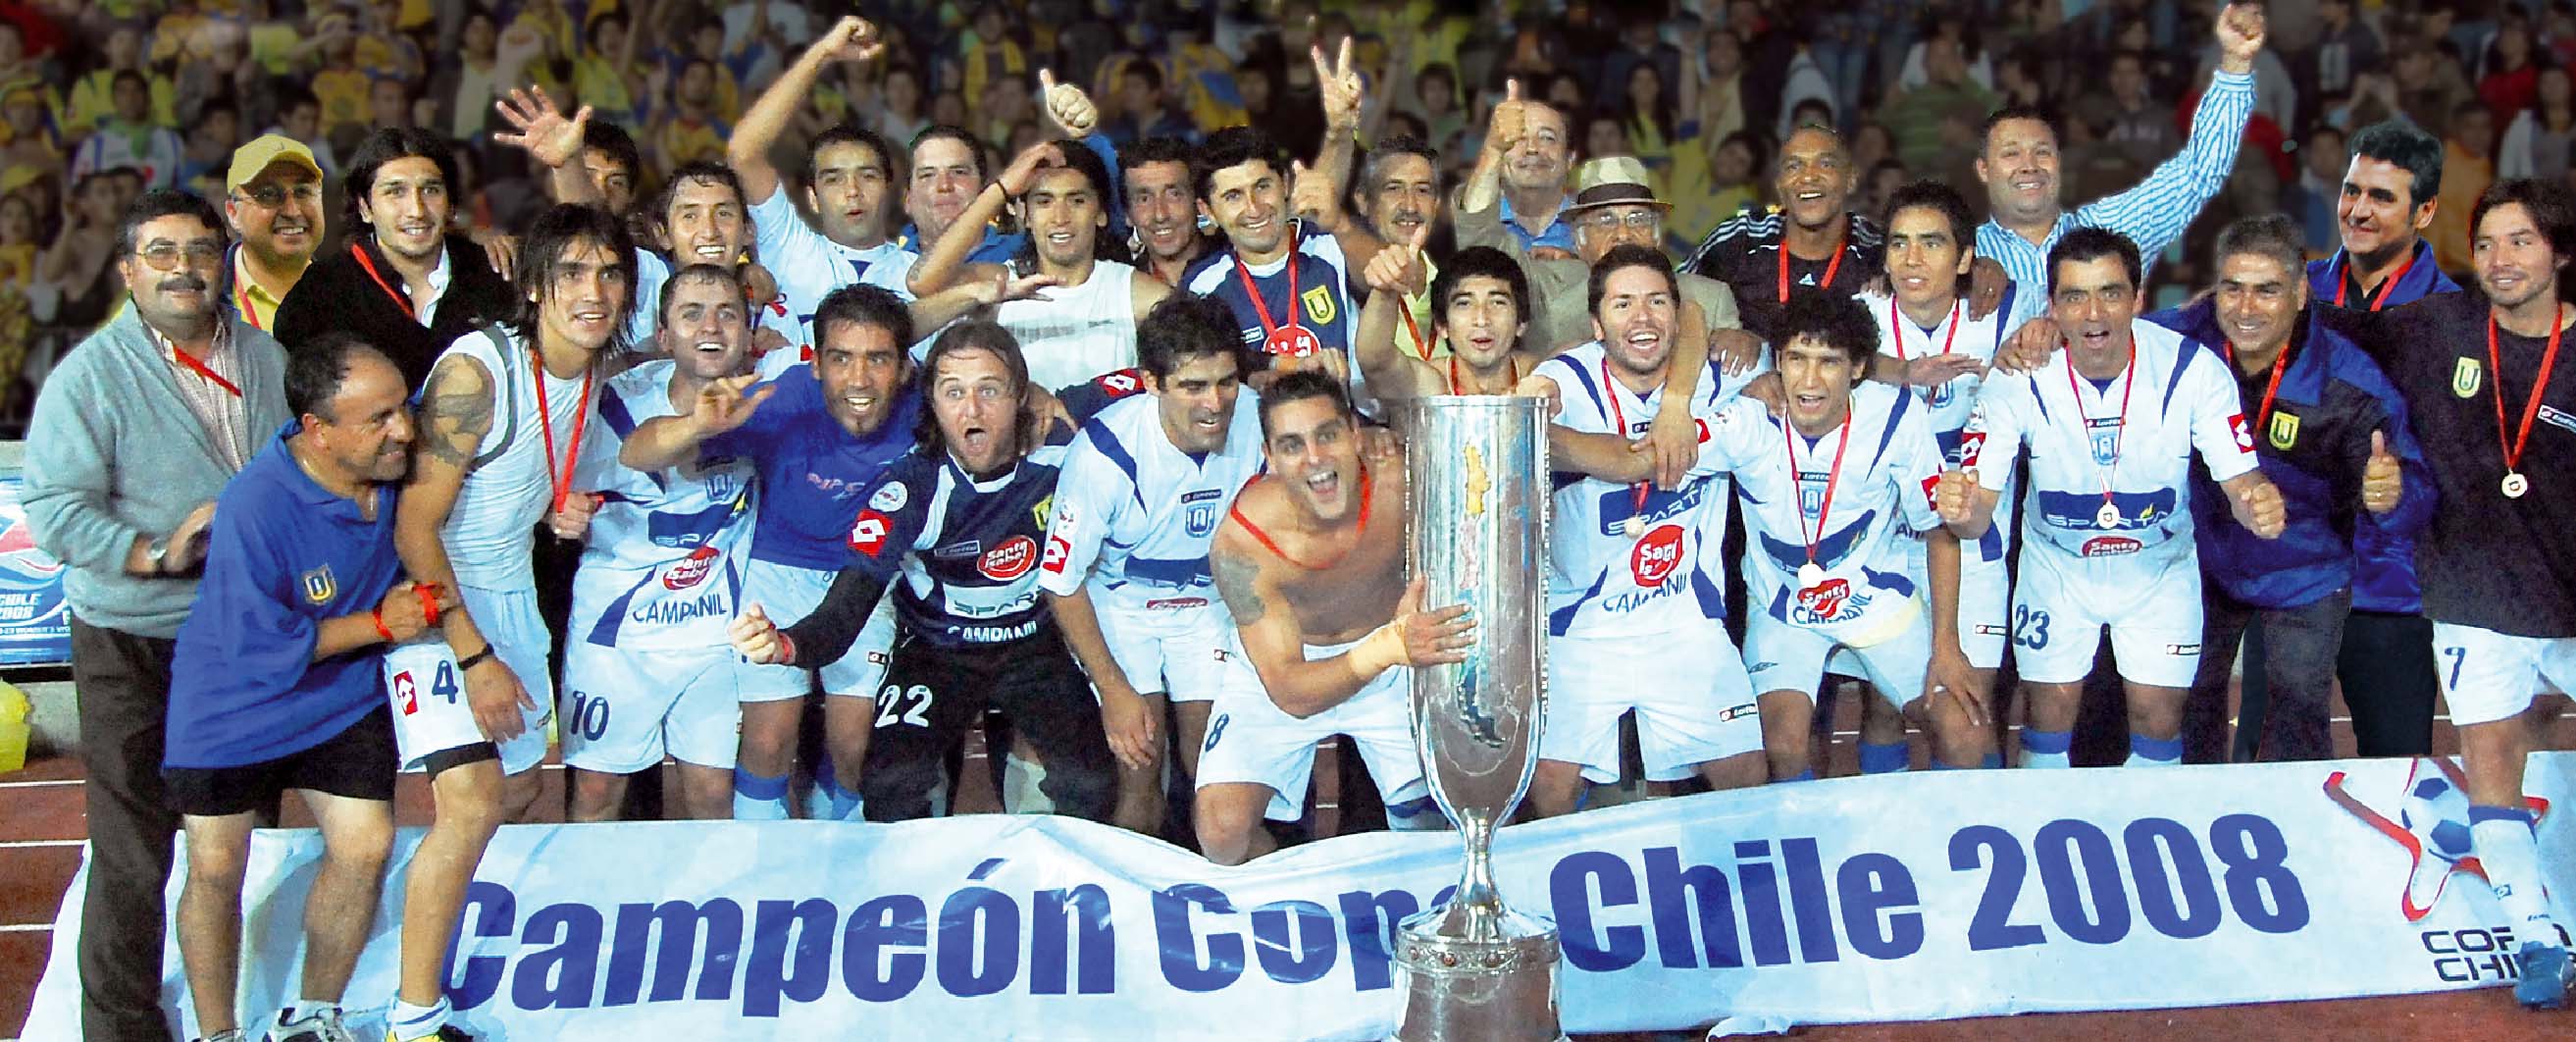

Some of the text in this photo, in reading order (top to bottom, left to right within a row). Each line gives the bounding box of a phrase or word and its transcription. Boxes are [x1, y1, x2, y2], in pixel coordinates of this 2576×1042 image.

[633, 593, 727, 624] CAMPANIL
[2014, 604, 2050, 651] 23
[432, 659, 458, 704] 4
[2445, 647, 2465, 691] 7
[571, 690, 609, 742] 10
[875, 685, 933, 728] 22
[1205, 712, 1230, 753] 8
[441, 813, 2310, 1017] Campeón Cop Chile 2008
